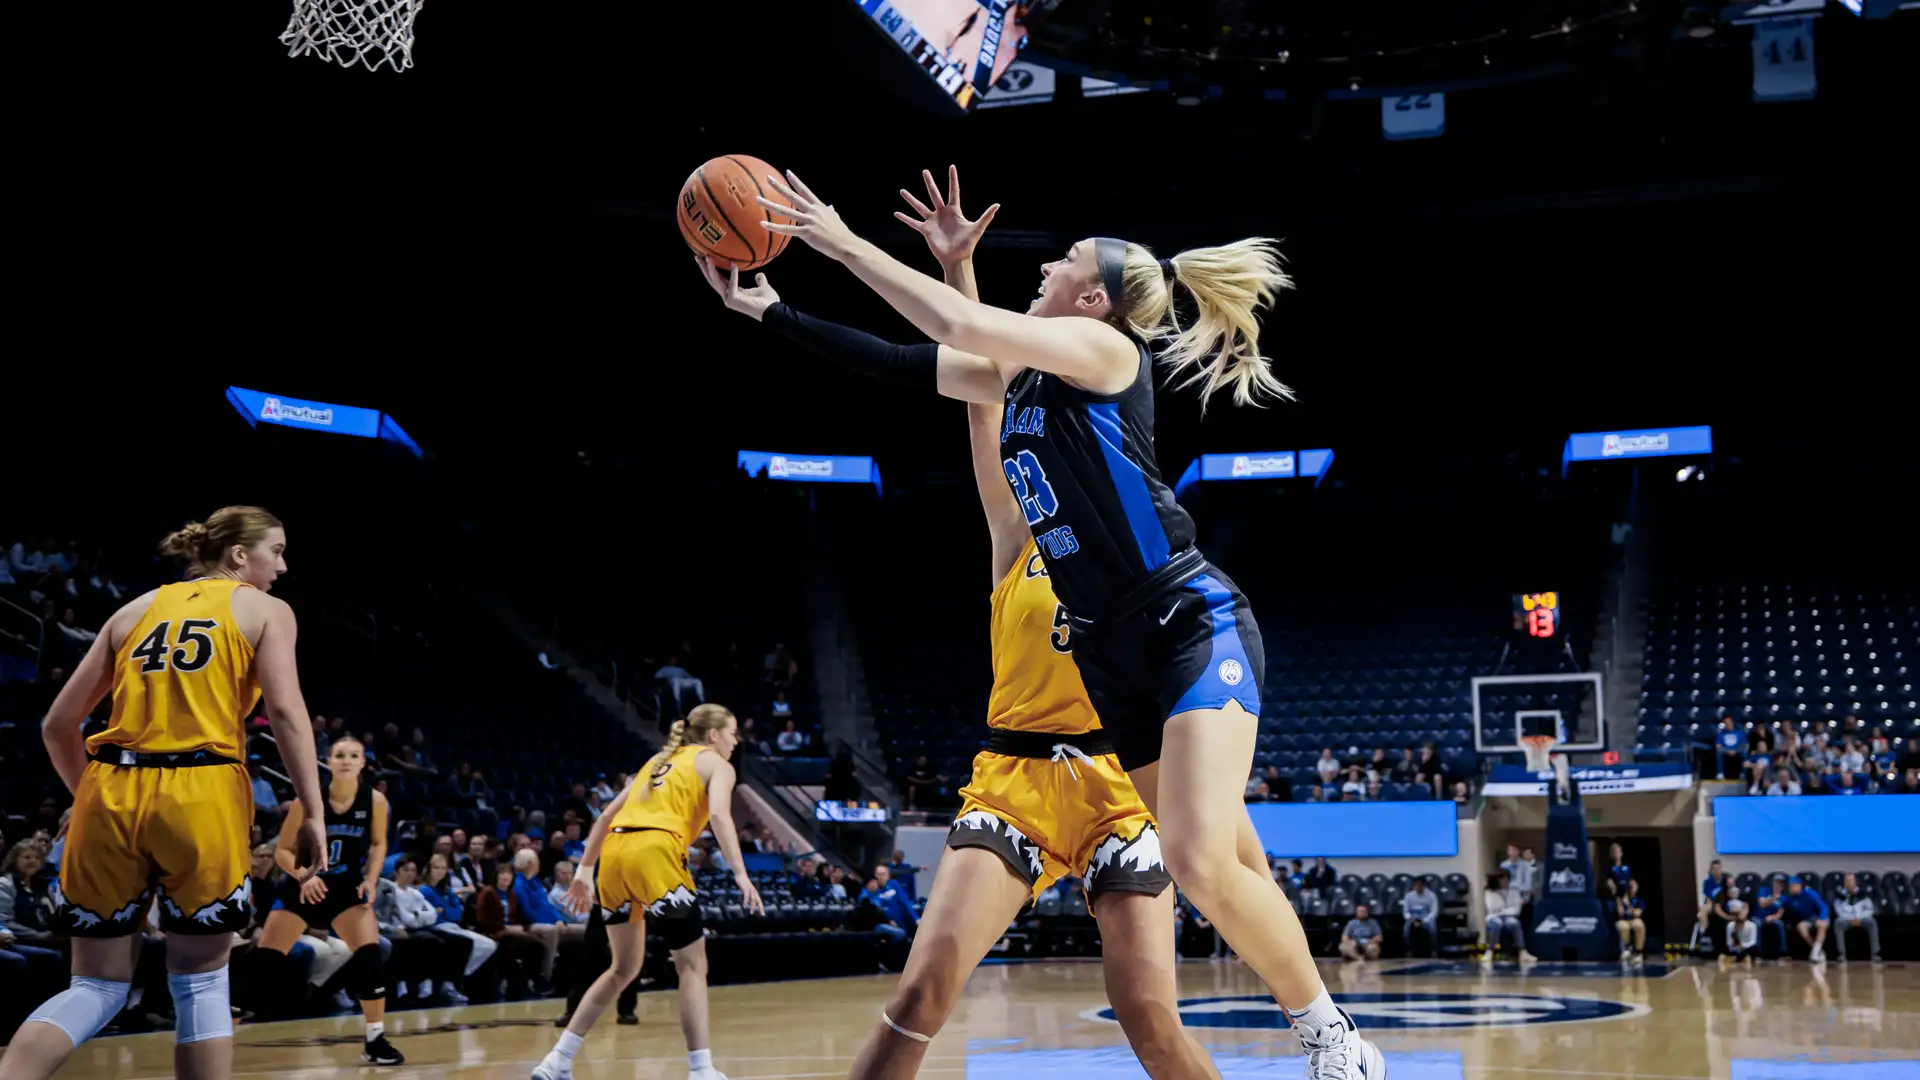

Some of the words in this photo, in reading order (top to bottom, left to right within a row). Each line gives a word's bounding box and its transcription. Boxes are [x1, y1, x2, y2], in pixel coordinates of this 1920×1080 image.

[682, 187, 723, 245] ELITE
[281, 406, 331, 421] mutual
[1003, 449, 1059, 526] 23
[129, 618, 219, 673] 45
[1049, 602, 1073, 654] 5
[1528, 608, 1554, 637] 13
